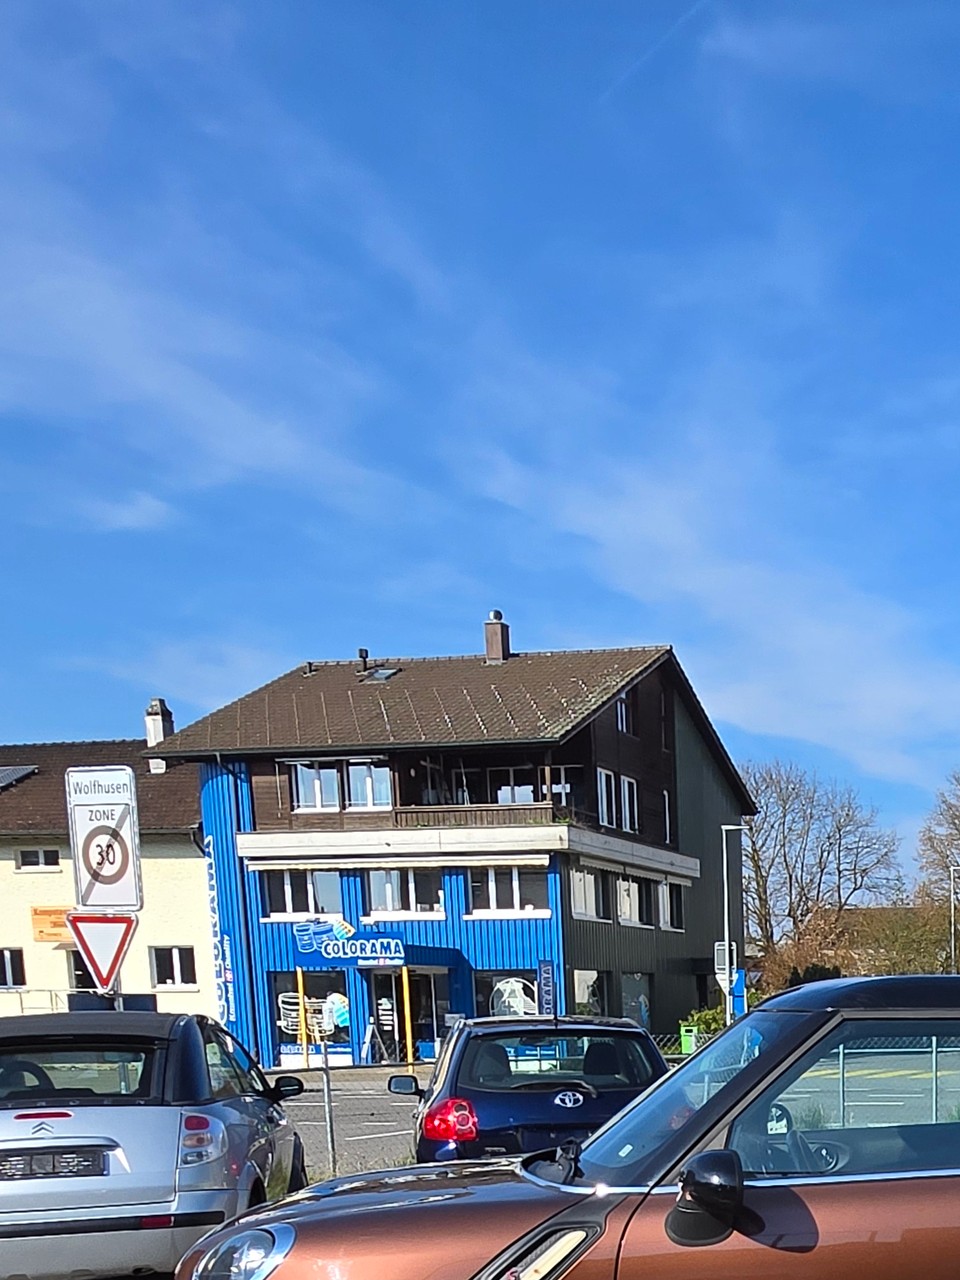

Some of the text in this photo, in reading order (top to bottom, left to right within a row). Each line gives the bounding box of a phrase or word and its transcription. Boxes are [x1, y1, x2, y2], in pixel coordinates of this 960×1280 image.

[72, 780, 129, 795] Wolfhusen
[88, 809, 116, 821] ZONE
[95, 843, 116, 866] 30
[323, 939, 404, 957] COLORAMA
